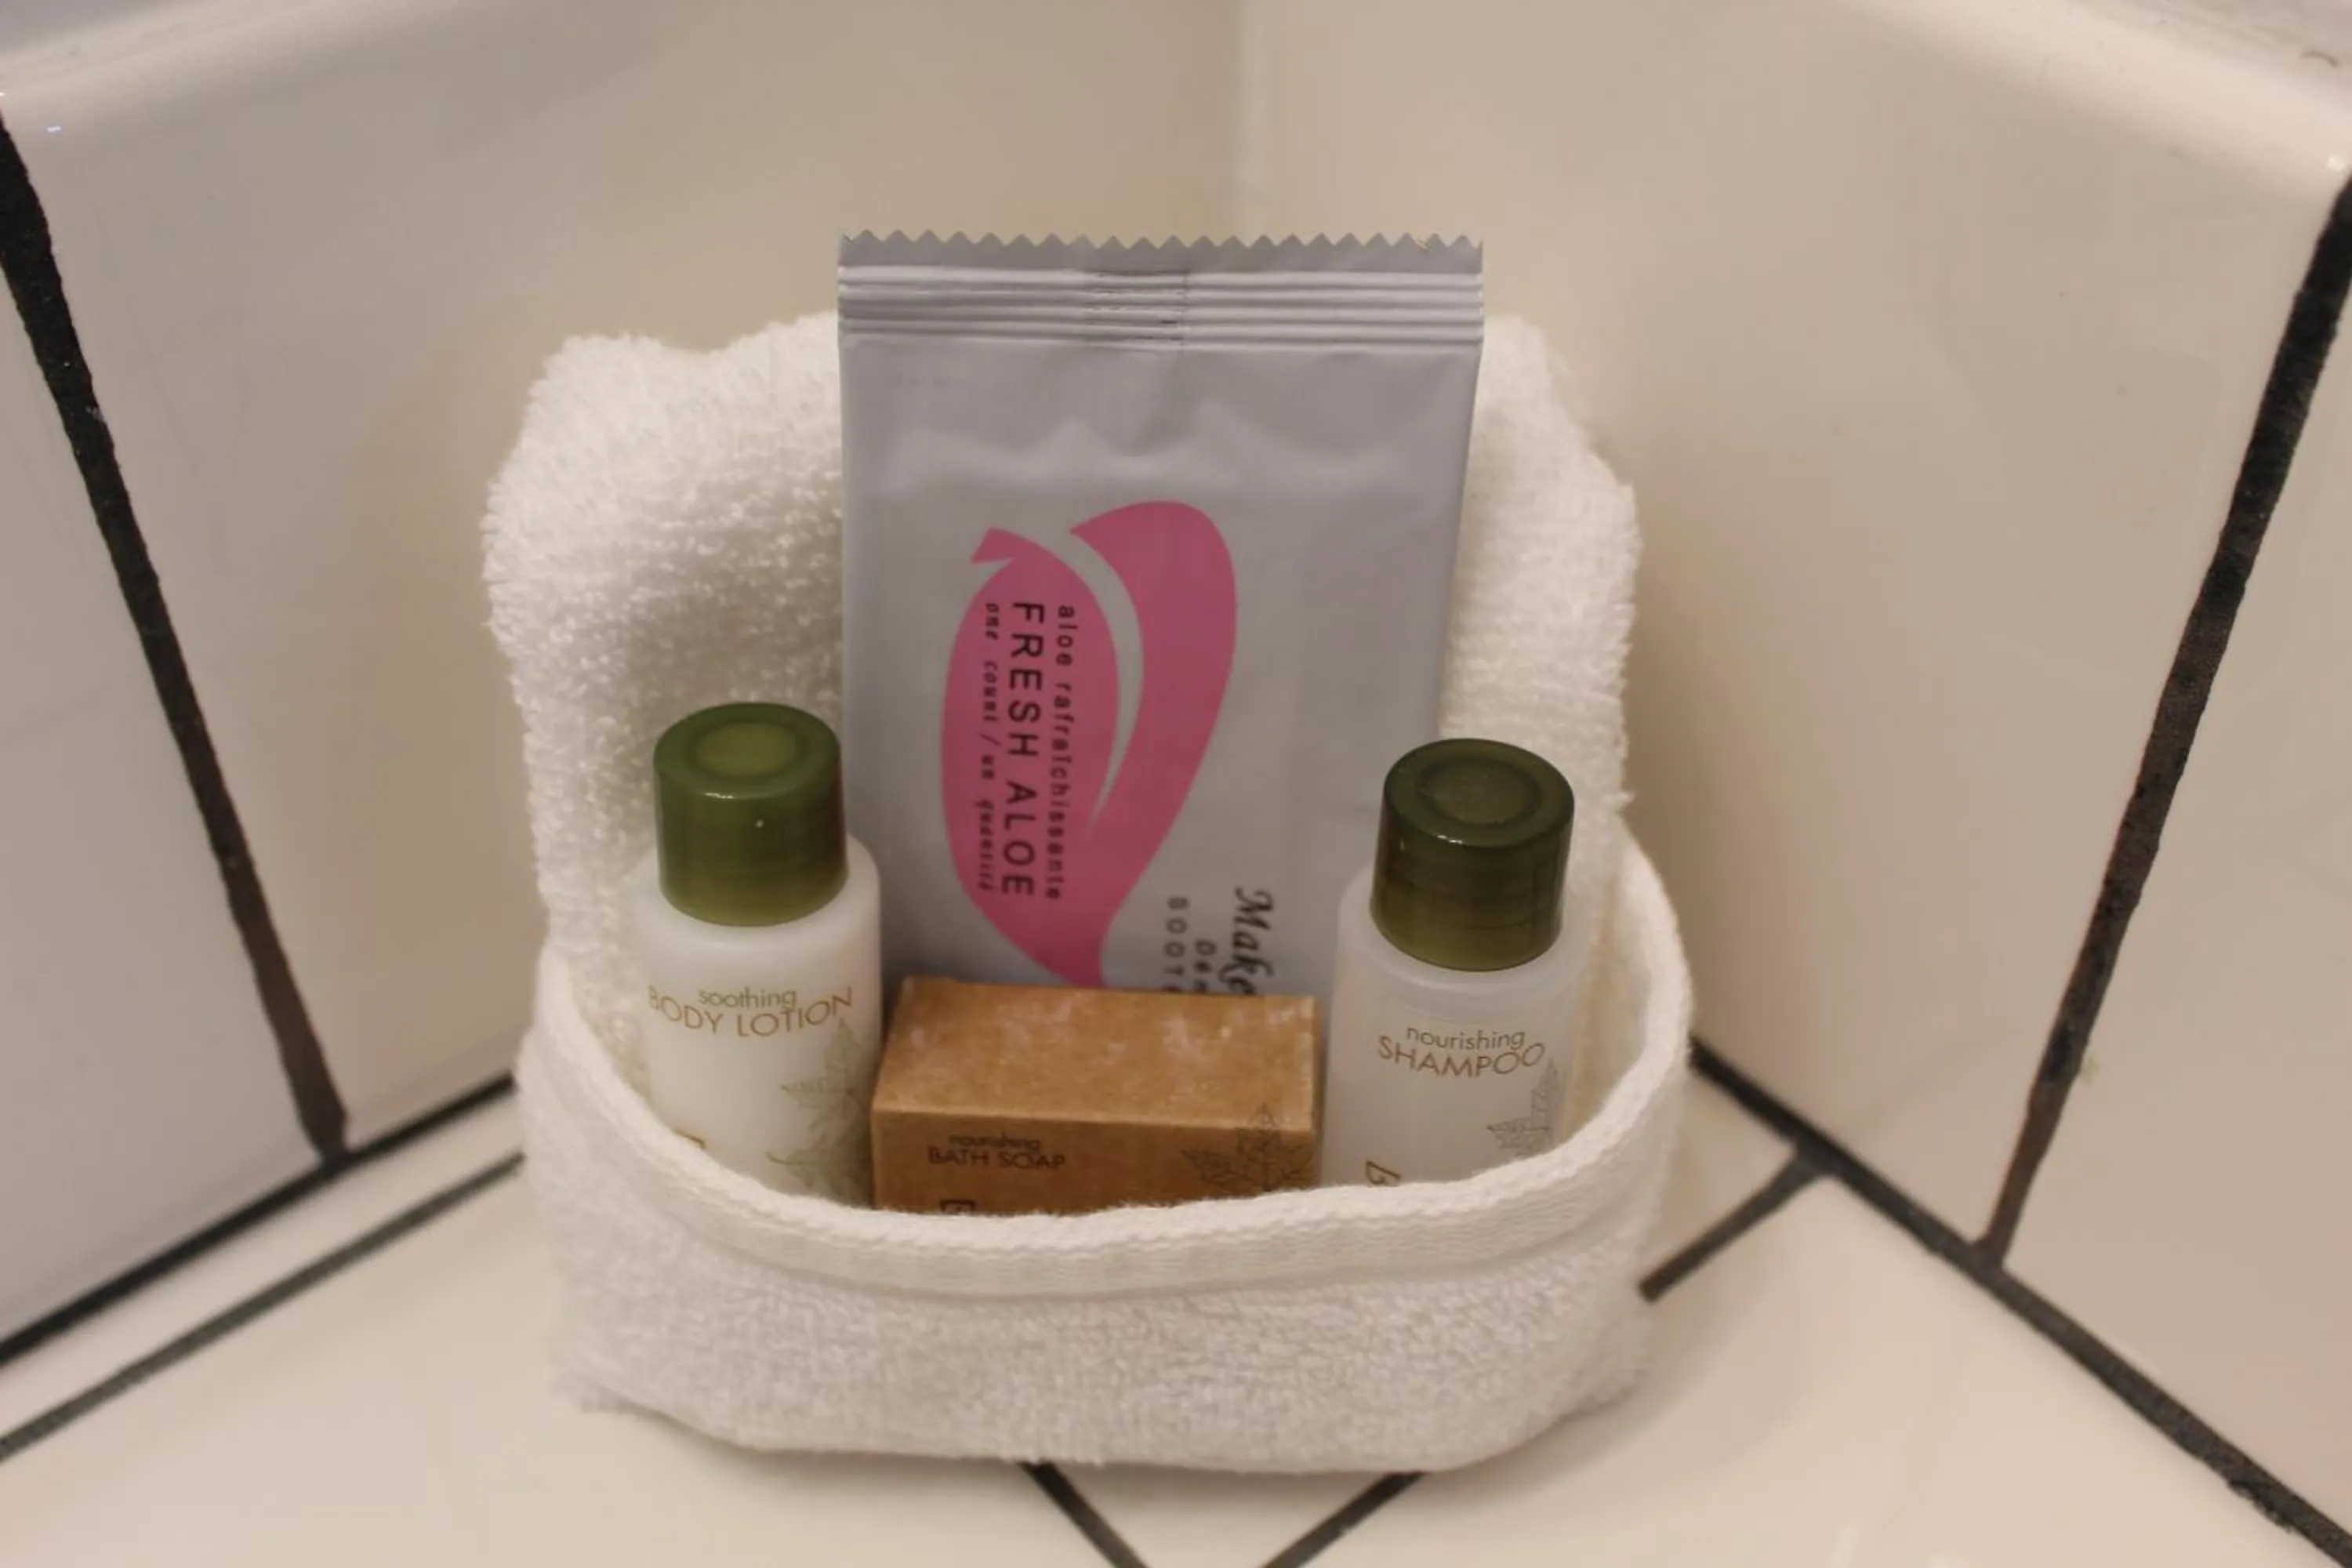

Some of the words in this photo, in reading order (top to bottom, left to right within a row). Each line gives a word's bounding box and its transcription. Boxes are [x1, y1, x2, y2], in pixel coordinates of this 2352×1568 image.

[984, 603, 1000, 640] one
[1056, 604, 1079, 666] aloe
[982, 661, 999, 722] count
[1007, 602, 1045, 757] FRESH
[1001, 779, 1037, 895] ALOE
[648, 985, 723, 1034] BODY
[737, 985, 852, 1036] LOTION
[698, 986, 797, 1011] soothing
[1377, 1035, 1545, 1078] SHAMPOO
[1406, 1027, 1526, 1051] nourishing
[927, 1145, 990, 1167] BATH
[997, 1150, 1067, 1170] SOAP
